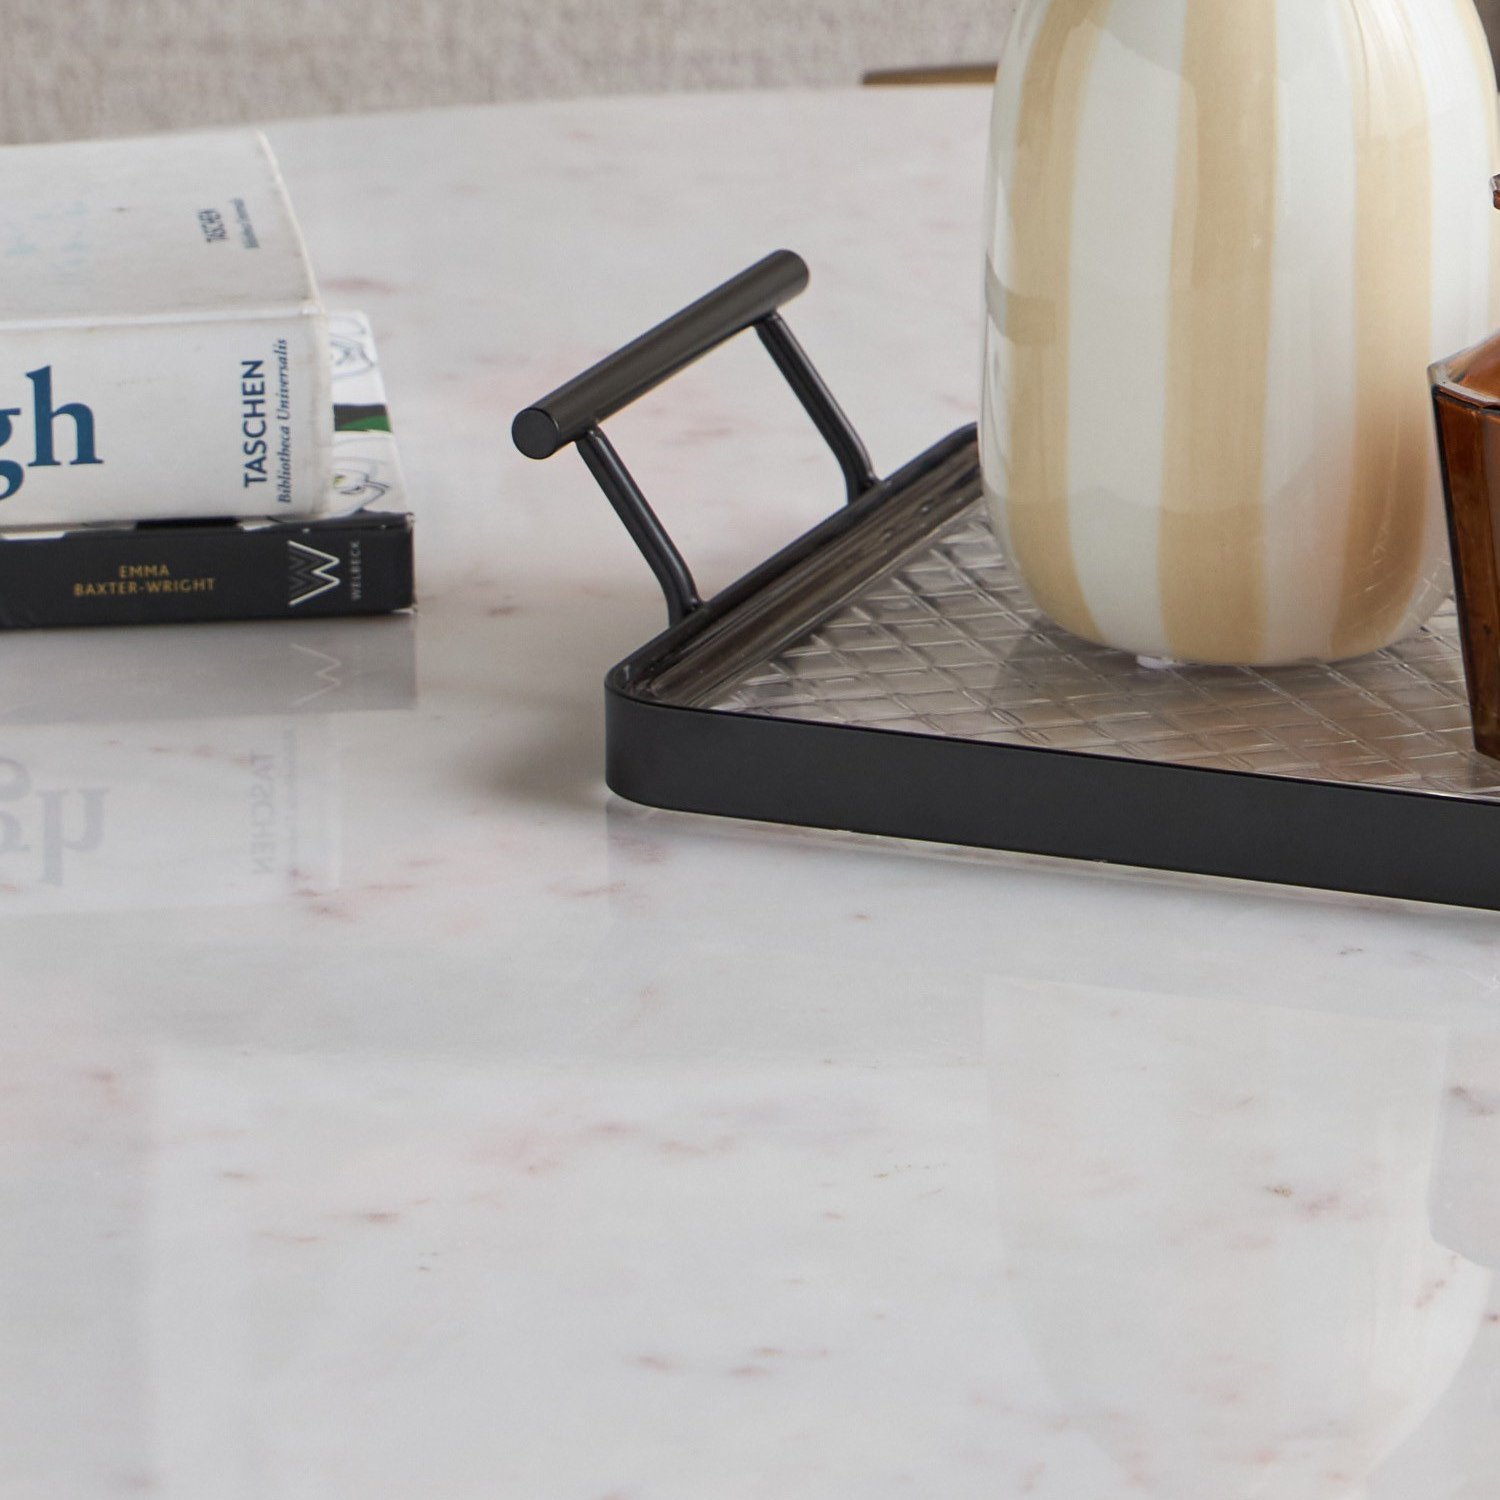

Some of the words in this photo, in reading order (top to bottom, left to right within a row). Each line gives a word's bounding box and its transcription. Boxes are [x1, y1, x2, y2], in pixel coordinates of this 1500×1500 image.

[274, 339, 291, 420] Universalis
[241, 359, 267, 488] TASCHEN
[277, 426, 292, 503] Bibliotheca
[73, 577, 216, 597] BAXTER-WRIGHT
[118, 563, 170, 579] EMMA
[349, 540, 362, 601] WELBECK
